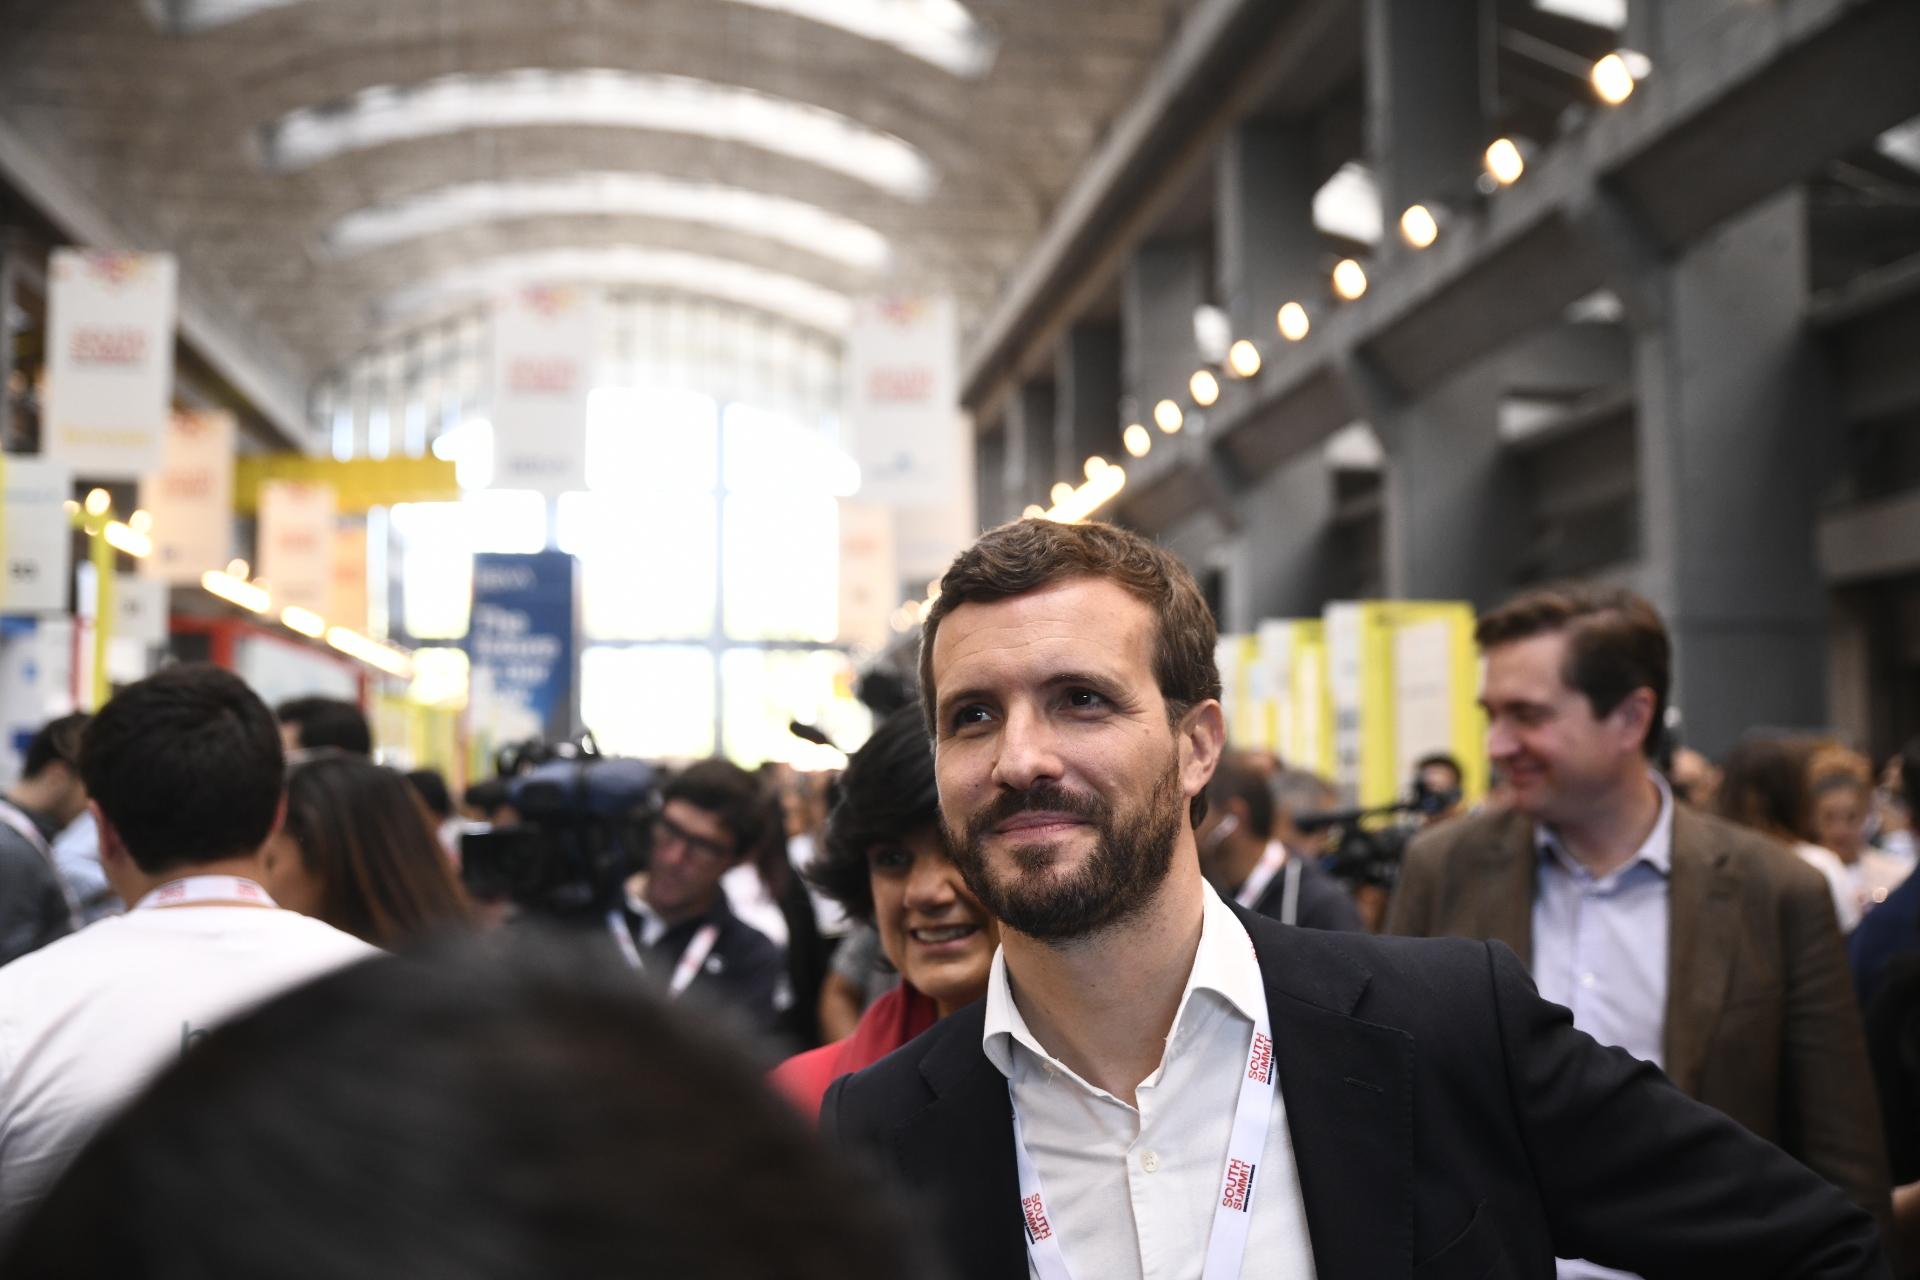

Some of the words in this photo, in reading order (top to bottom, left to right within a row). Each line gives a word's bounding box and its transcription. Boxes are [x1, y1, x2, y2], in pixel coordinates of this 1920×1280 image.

[1248, 1032, 1265, 1080] SOUTH
[1258, 1035, 1273, 1083] SUMMIT
[1222, 1158, 1241, 1208] SOUTH
[1233, 1161, 1250, 1211] SUMMIT
[1022, 1197, 1043, 1241] SUMMIT
[1031, 1193, 1052, 1239] SOUTH
